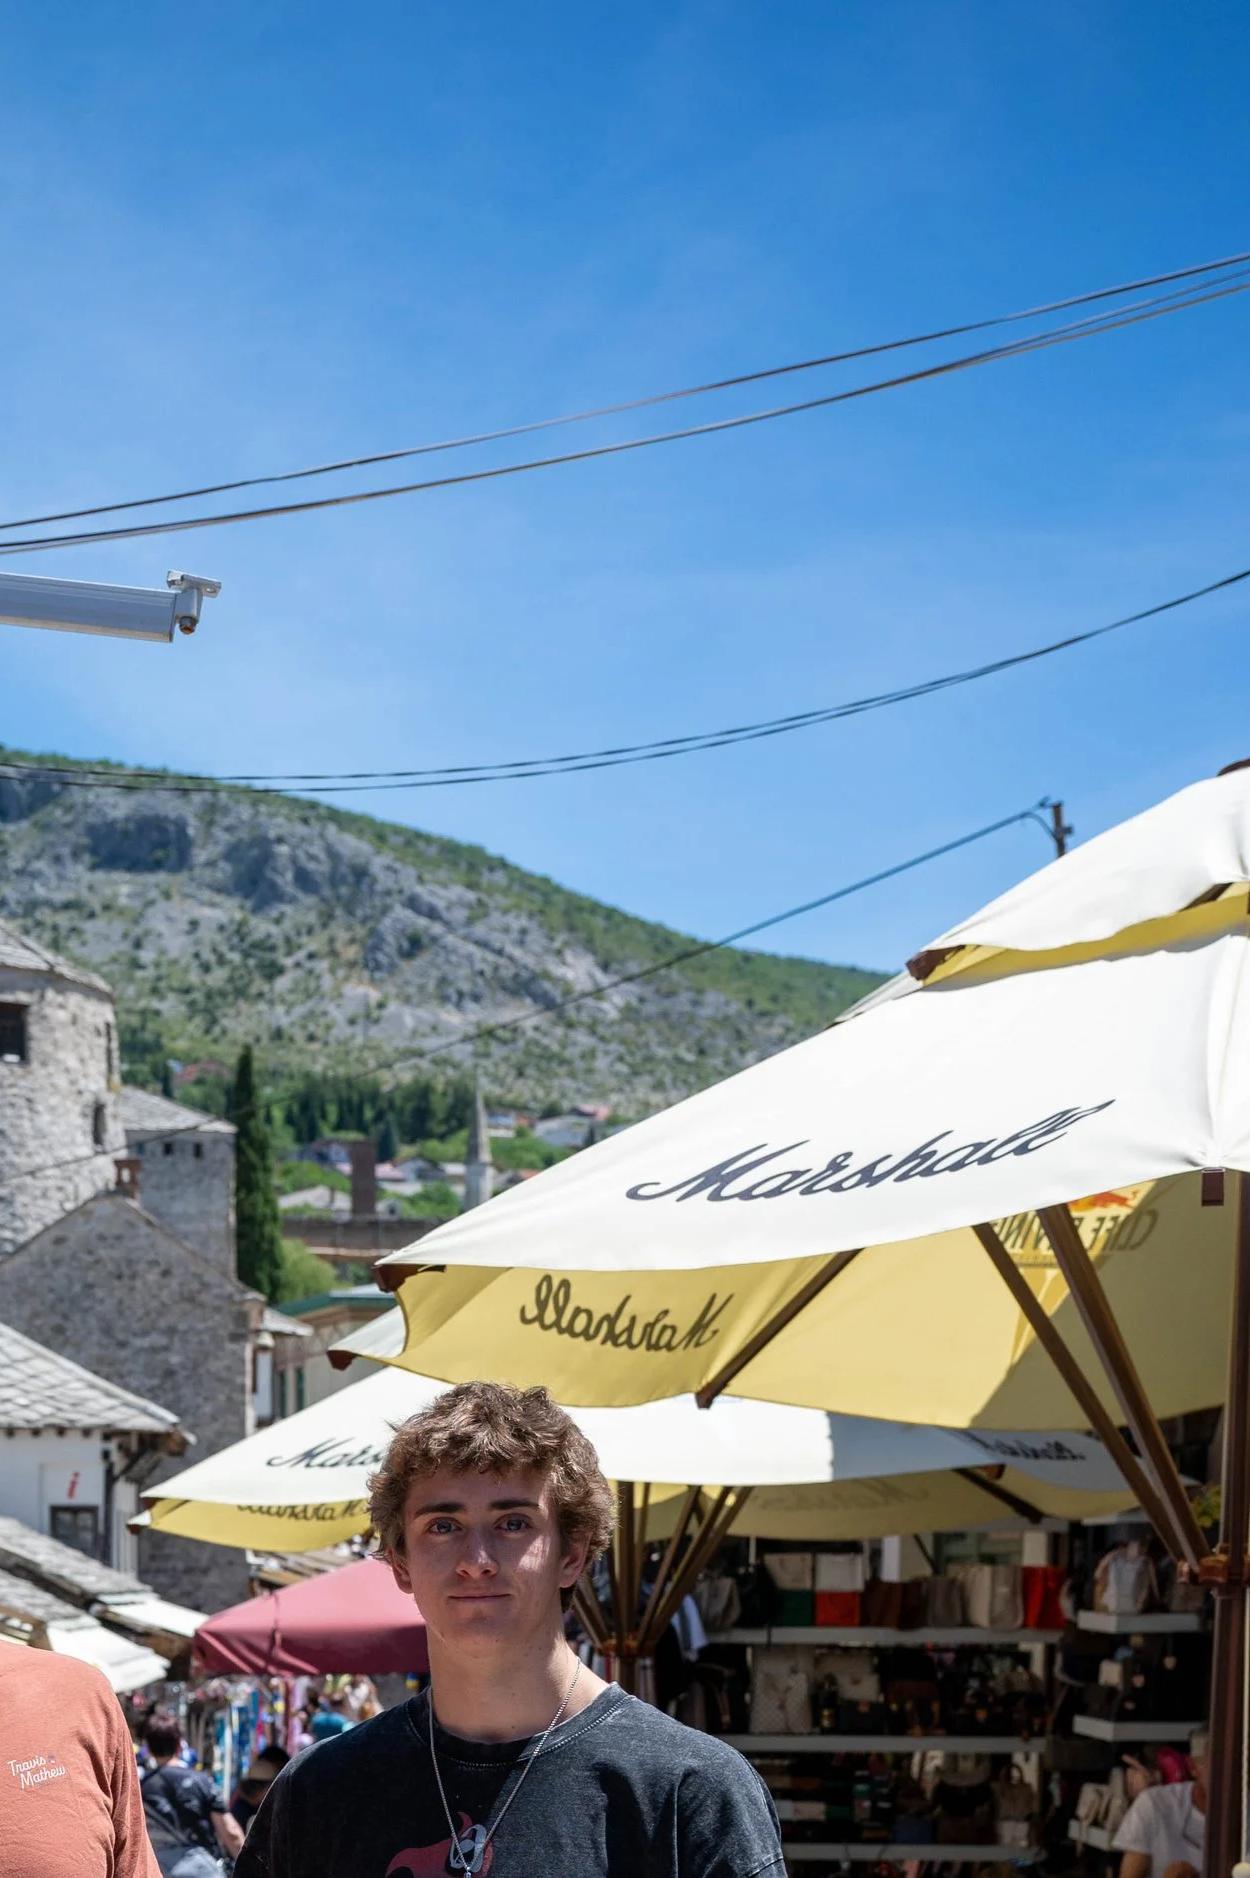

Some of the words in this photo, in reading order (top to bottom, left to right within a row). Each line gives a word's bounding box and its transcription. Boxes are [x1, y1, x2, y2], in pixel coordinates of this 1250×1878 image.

[626, 1099, 1115, 1202] Marshall
[266, 1437, 384, 1468] Mars
[7, 1755, 46, 1776] Travis
[20, 1766, 66, 1789] Mathew
